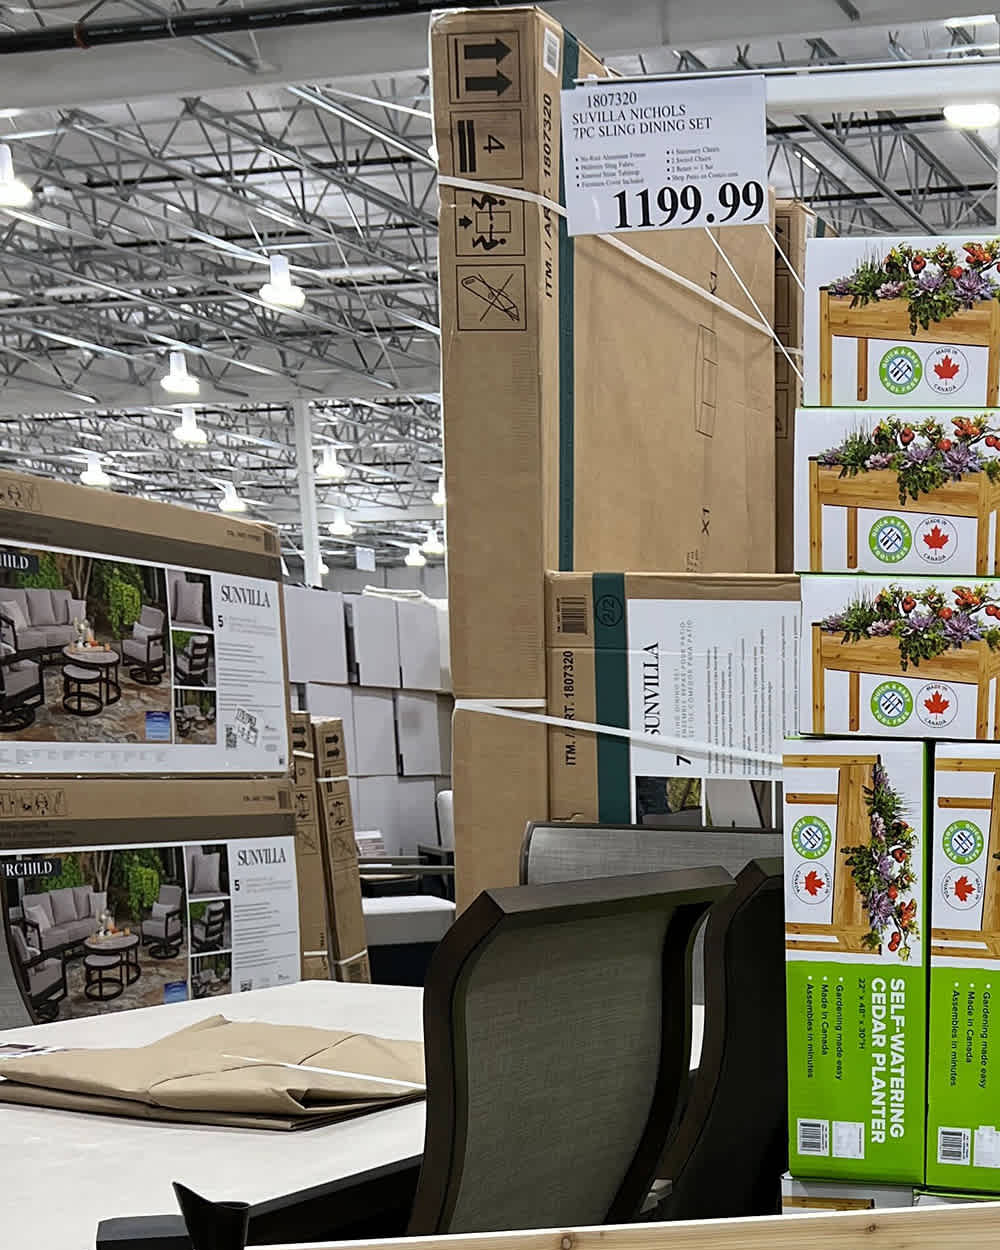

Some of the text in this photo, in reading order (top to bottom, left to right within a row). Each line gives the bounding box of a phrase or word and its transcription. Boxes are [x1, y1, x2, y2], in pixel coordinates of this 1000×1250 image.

[587, 91, 638, 109] 1807320
[572, 104, 686, 126] SUVILLA NICHOLS
[543, 93, 552, 178] 1807320
[573, 117, 713, 140] 7PC SLING DINING SET
[483, 134, 505, 154] 4
[614, 181, 765, 229] 1199.99
[221, 584, 271, 608] SUNVILLA
[562, 650, 576, 699] 1807320
[676, 754, 692, 767] 7
[237, 848, 286, 866] SUNVILLA
[234, 880, 240, 891] 5
[871, 977, 887, 1143] CEDAR PLANTER
[890, 978, 905, 1138] SELF-WATERING
